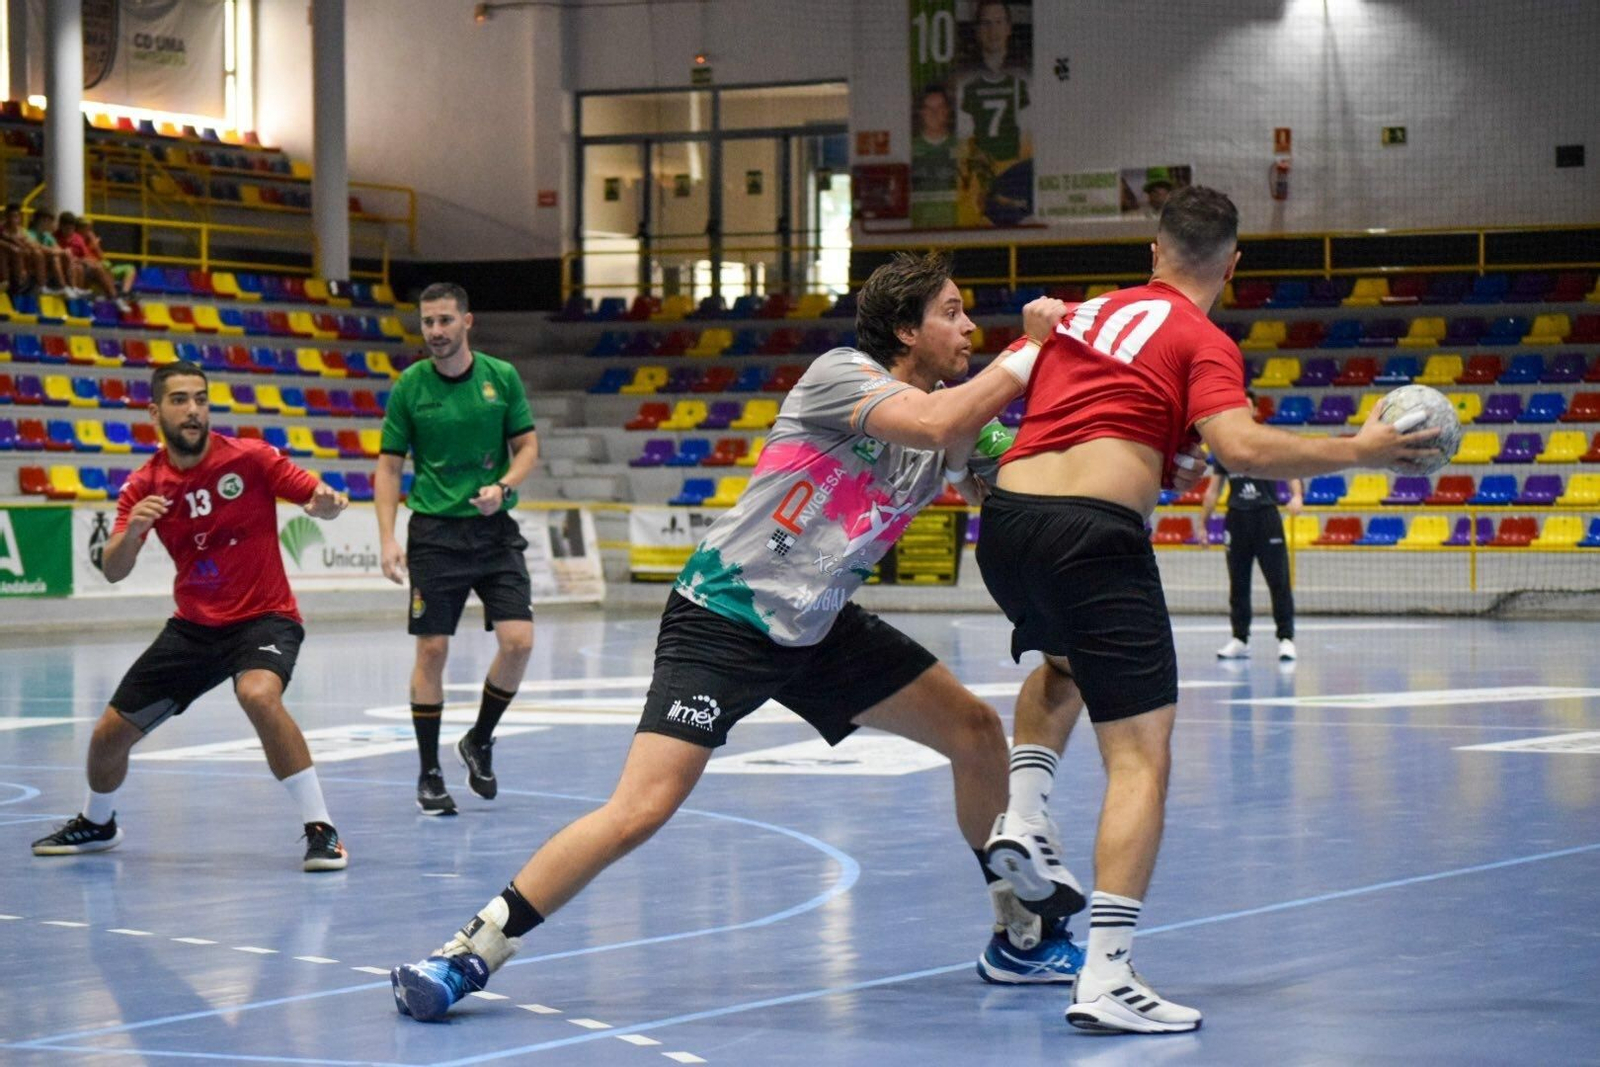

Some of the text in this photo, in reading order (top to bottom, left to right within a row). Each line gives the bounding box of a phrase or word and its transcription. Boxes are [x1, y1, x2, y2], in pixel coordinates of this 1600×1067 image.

[911, 9, 954, 63] 10
[983, 100, 1008, 137] 7
[1056, 297, 1171, 364] 10
[184, 488, 212, 519] 13
[323, 544, 378, 572] Unicaja
